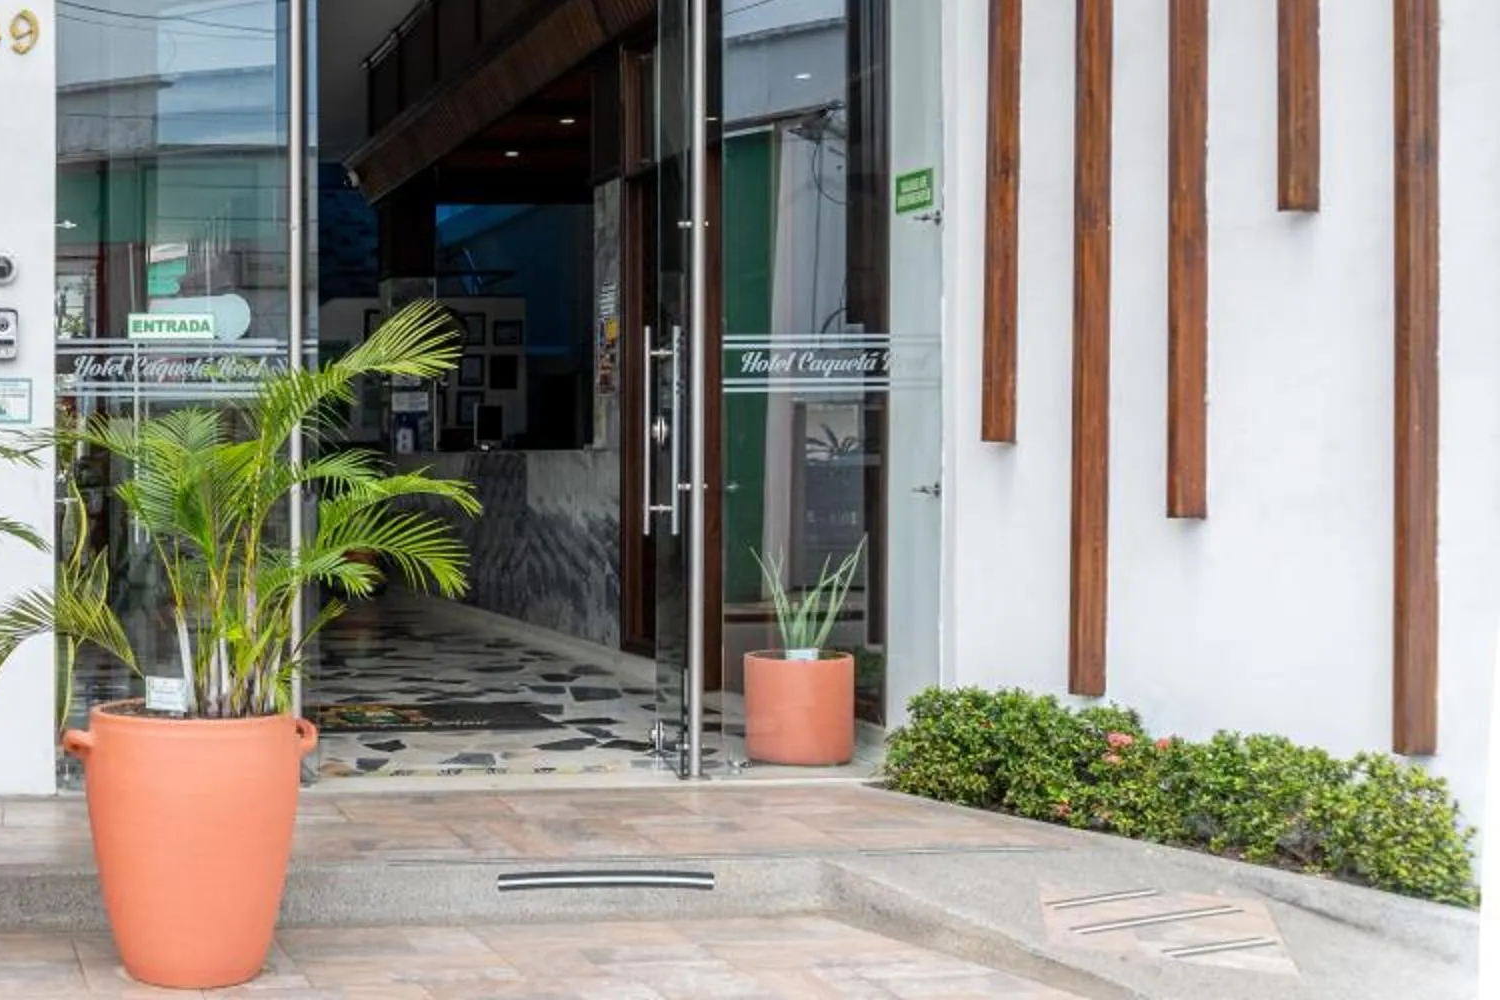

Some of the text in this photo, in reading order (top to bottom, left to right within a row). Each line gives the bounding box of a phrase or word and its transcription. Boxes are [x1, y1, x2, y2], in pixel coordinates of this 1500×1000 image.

[131, 319, 212, 334] ENTRADA
[73, 355, 128, 377] Hotel
[740, 351, 796, 373] Hotel
[798, 352, 878, 377] Caquetá
